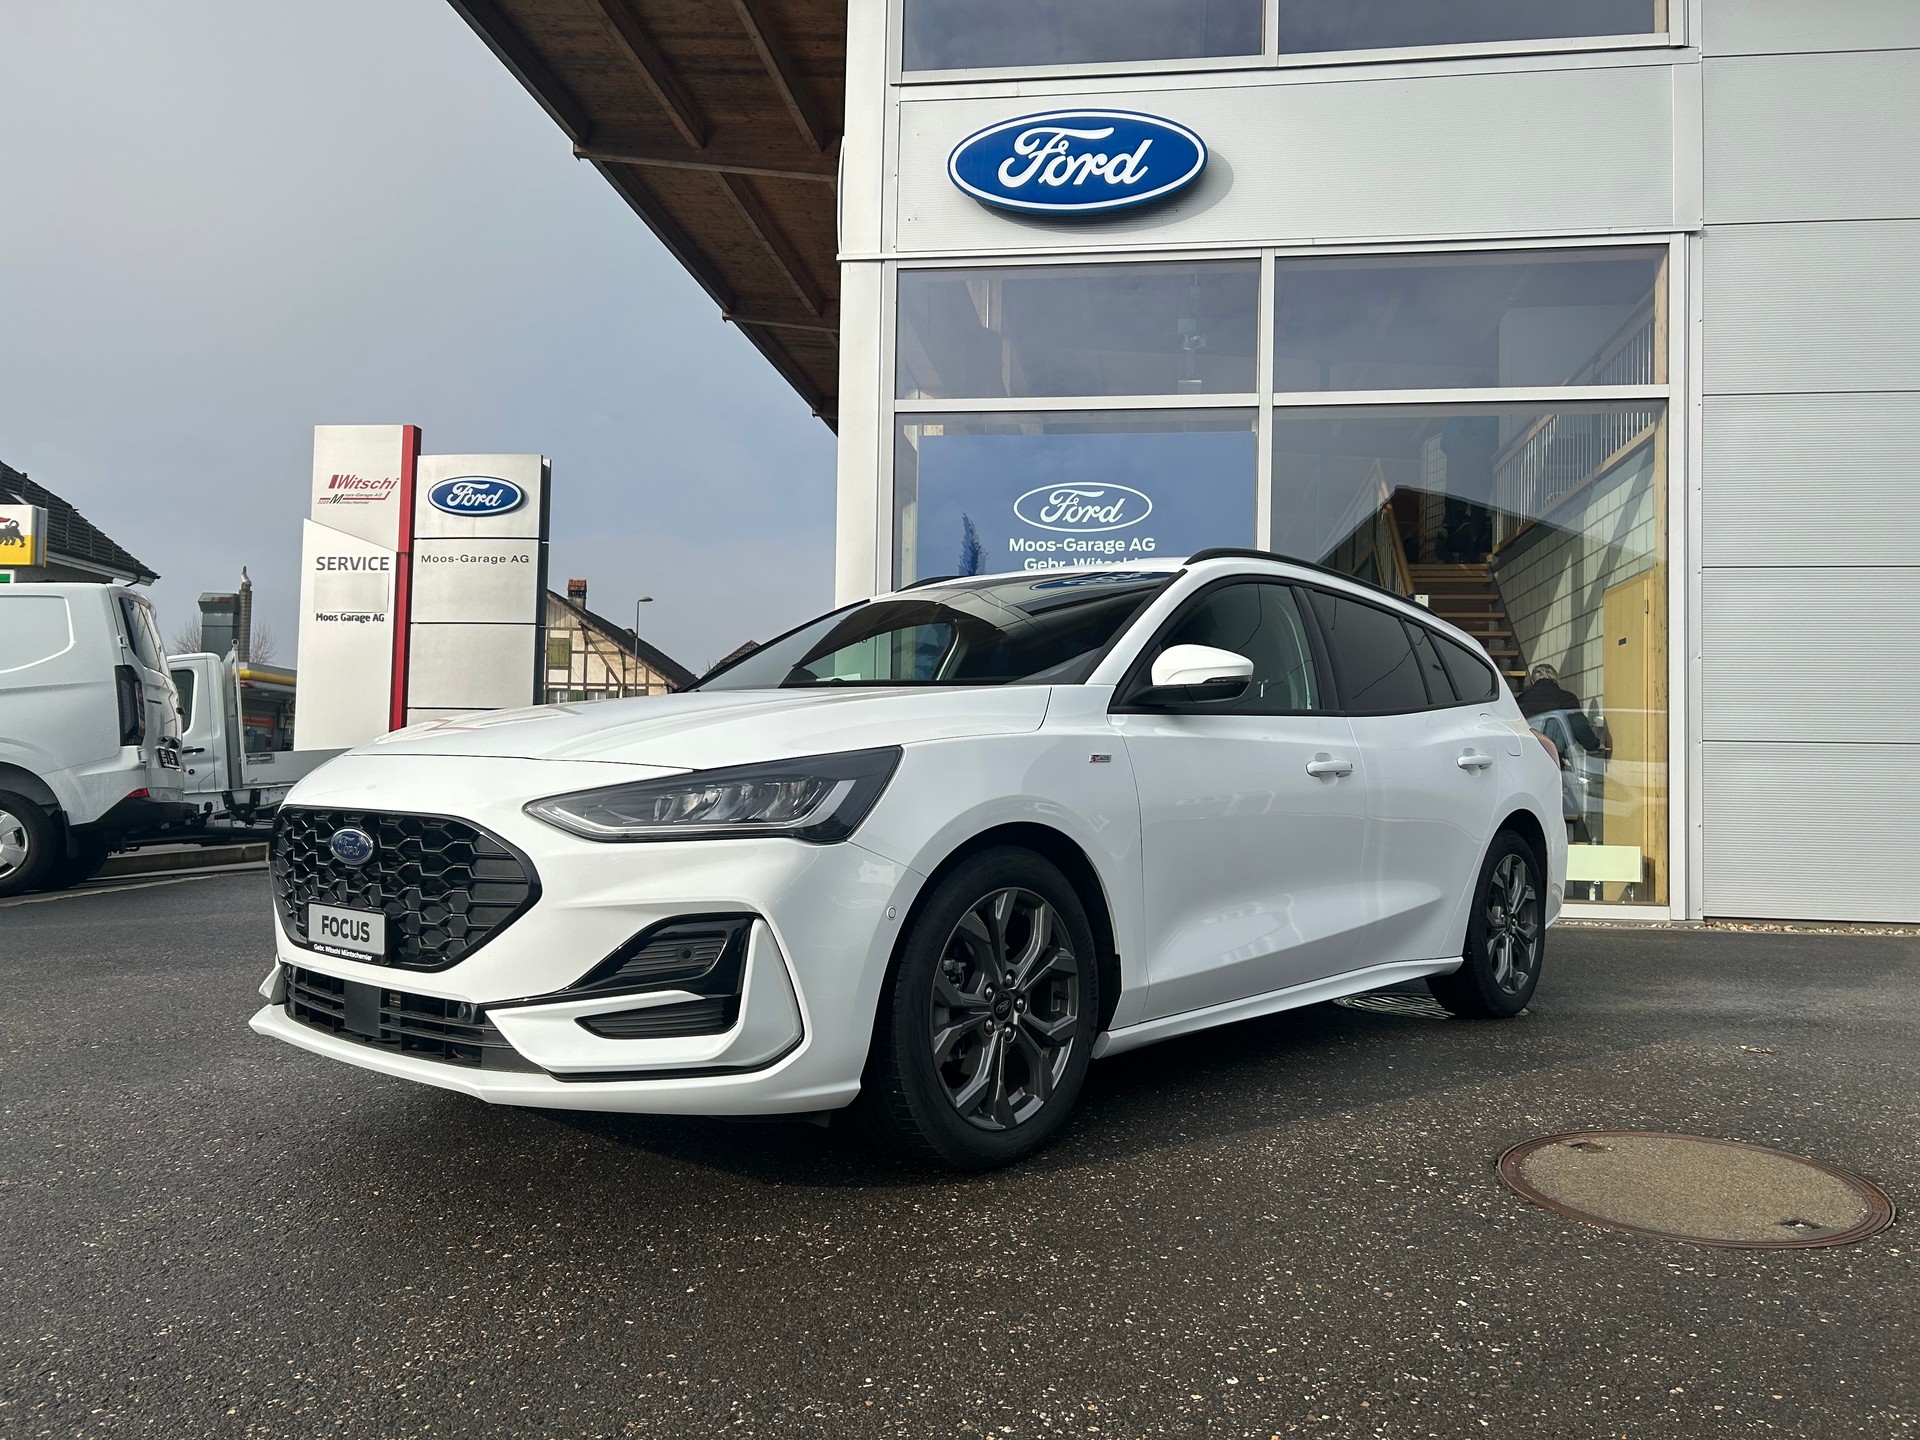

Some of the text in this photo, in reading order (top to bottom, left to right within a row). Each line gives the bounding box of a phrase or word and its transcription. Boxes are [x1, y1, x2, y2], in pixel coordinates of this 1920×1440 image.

[998, 126, 1153, 188] Ford
[336, 474, 400, 490] Witschi
[446, 482, 503, 507] Ford
[1040, 489, 1126, 523] Ford
[1009, 537, 1156, 554] Moos-Garage AG
[315, 556, 390, 571] SERVICE
[421, 554, 530, 565] Moos-Garage AG
[315, 612, 385, 624] Moos Garage AG
[337, 835, 360, 856] Ford
[321, 914, 370, 943] FOCUS
